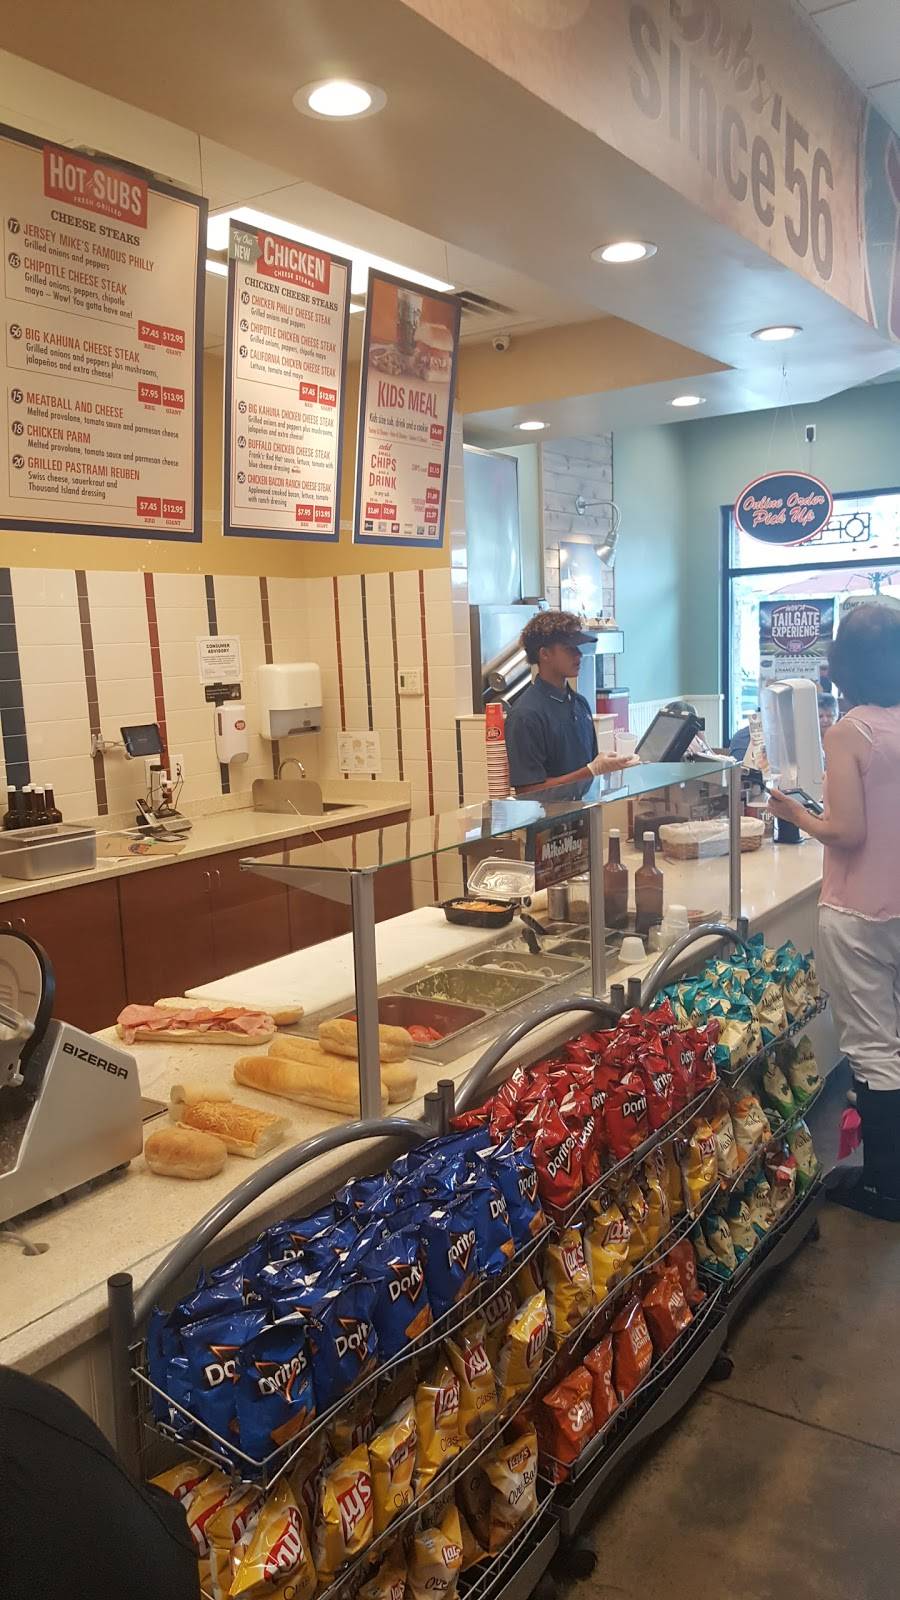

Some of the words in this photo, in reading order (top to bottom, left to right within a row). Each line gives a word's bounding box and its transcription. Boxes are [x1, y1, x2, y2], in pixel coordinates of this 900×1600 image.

[627, 4, 776, 228] Since
[770, 92, 835, 281] '56
[50, 152, 87, 194] HOT
[93, 169, 142, 216] SUBS
[73, 195, 94, 207] FRESH
[96, 200, 122, 217] GRILLED
[9, 218, 20, 234] 17
[51, 209, 96, 233] CHEESE
[99, 224, 141, 246] STEAKS
[23, 223, 57, 243] JERSEY
[59, 235, 90, 253] MIKE'S
[91, 243, 127, 264] FAMOUS
[128, 254, 155, 272] PHILLY
[24, 238, 47, 254] Grilled
[48, 247, 70, 260] onions
[71, 252, 84, 265] and
[85, 256, 110, 271] peppers
[234, 243, 251, 261] NEW
[264, 236, 325, 283] CHICKEN
[23, 256, 66, 279] CHIPOTLE
[68, 269, 100, 288] CHEESE
[101, 279, 127, 296] STEAK
[274, 270, 294, 279] CHEESE
[24, 272, 47, 287] Grilled
[48, 280, 71, 293] onions,
[101, 292, 125, 307] chipotle
[244, 276, 280, 294] CHICKEN
[281, 287, 310, 304] CHEESE
[311, 296, 339, 312] STEAKS
[24, 286, 44, 299] mayo
[53, 290, 71, 304] Wow!
[73, 293, 85, 306] You
[85, 299, 102, 312] gotta
[103, 303, 118, 316] have
[119, 307, 133, 319] one!
[251, 294, 275, 311] CHICKEN
[276, 300, 294, 315] PHILLY
[295, 306, 314, 320] CHEESE
[315, 313, 331, 325] STEAK
[25, 327, 40, 341] BIG
[43, 331, 81, 349] KAHUNA
[82, 340, 113, 357] CHEESE
[114, 347, 140, 363] STEAK
[141, 326, 160, 338] $7.45
[162, 331, 184, 345] $12.95
[251, 321, 276, 338] CHIPOTLE
[277, 329, 300, 344] CHICKEN
[300, 336, 320, 350] CHEESE
[320, 341, 336, 353] STEAK
[26, 343, 49, 355] Grilled
[50, 350, 71, 360] onions
[72, 352, 85, 363] and
[85, 356, 110, 368] peppers
[111, 360, 123, 371] plus
[249, 349, 280, 365] CALIFORNIA
[281, 357, 302, 370] CHICKEN
[302, 362, 320, 374] CHEESE
[320, 366, 336, 377] STEAK
[59, 361, 72, 371] and
[73, 364, 90, 375] extra
[91, 367, 114, 379] cheese!
[12, 389, 22, 402] 15
[26, 391, 73, 411] MEATBALL
[74, 398, 93, 413] AND
[94, 403, 124, 419] CHEESE
[140, 388, 159, 399] $7.95
[377, 380, 405, 409] KIDS
[407, 389, 438, 419] MEAL
[27, 406, 49, 418] Melted
[83, 416, 105, 427] tomato
[106, 420, 121, 430] sauce
[122, 421, 134, 432] and
[161, 427, 179, 439] cheese
[248, 402, 258, 414] BIG
[258, 406, 280, 418] KAHUNA
[281, 409, 302, 422] CHICKEN
[302, 413, 319, 424] CHEESE
[319, 417, 334, 427] STEAK
[13, 421, 24, 435] 18
[27, 424, 64, 441] CHICKEN
[66, 429, 91, 444] PARM
[27, 439, 49, 451] Melted
[84, 447, 105, 458] tomato
[106, 451, 121, 461] sauce
[123, 452, 134, 462] and
[161, 457, 179, 467] cheese
[248, 439, 272, 452] BUFFALO
[272, 443, 295, 455] CHICKEN
[295, 446, 315, 458] CHEESE
[315, 449, 331, 460] STEAK
[13, 456, 24, 469] 20
[27, 456, 63, 472] GRILLED
[65, 461, 108, 477] PASTRAMI
[110, 466, 140, 481] REUBEN
[370, 454, 397, 472] CHIPS
[28, 471, 46, 481] Swiss
[47, 473, 70, 485] cheese,
[71, 476, 105, 488] sauerkraut
[106, 479, 118, 489] and
[28, 481, 59, 494] Thousand
[60, 485, 80, 496] Island
[81, 486, 106, 500] dressing
[247, 474, 268, 485] CHICKEN
[285, 478, 301, 489] RANCH
[301, 480, 317, 491] CHEESE
[317, 482, 332, 493] STEAK
[368, 472, 397, 490] DRINK
[162, 503, 184, 514] $12.95
[743, 496, 783, 511] Online
[787, 492, 825, 507] Order
[752, 508, 787, 528] Pick
[789, 506, 815, 527] Up
[771, 625, 820, 638] EXPERIENCE
[772, 611, 820, 627] TAILGATE
[62, 1042, 129, 1080] BIZERBA
[623, 1097, 647, 1117] Dori
[546, 1137, 575, 1178] Dorito
[518, 1170, 538, 1196] Dorit
[258, 1351, 308, 1396] Doritos
